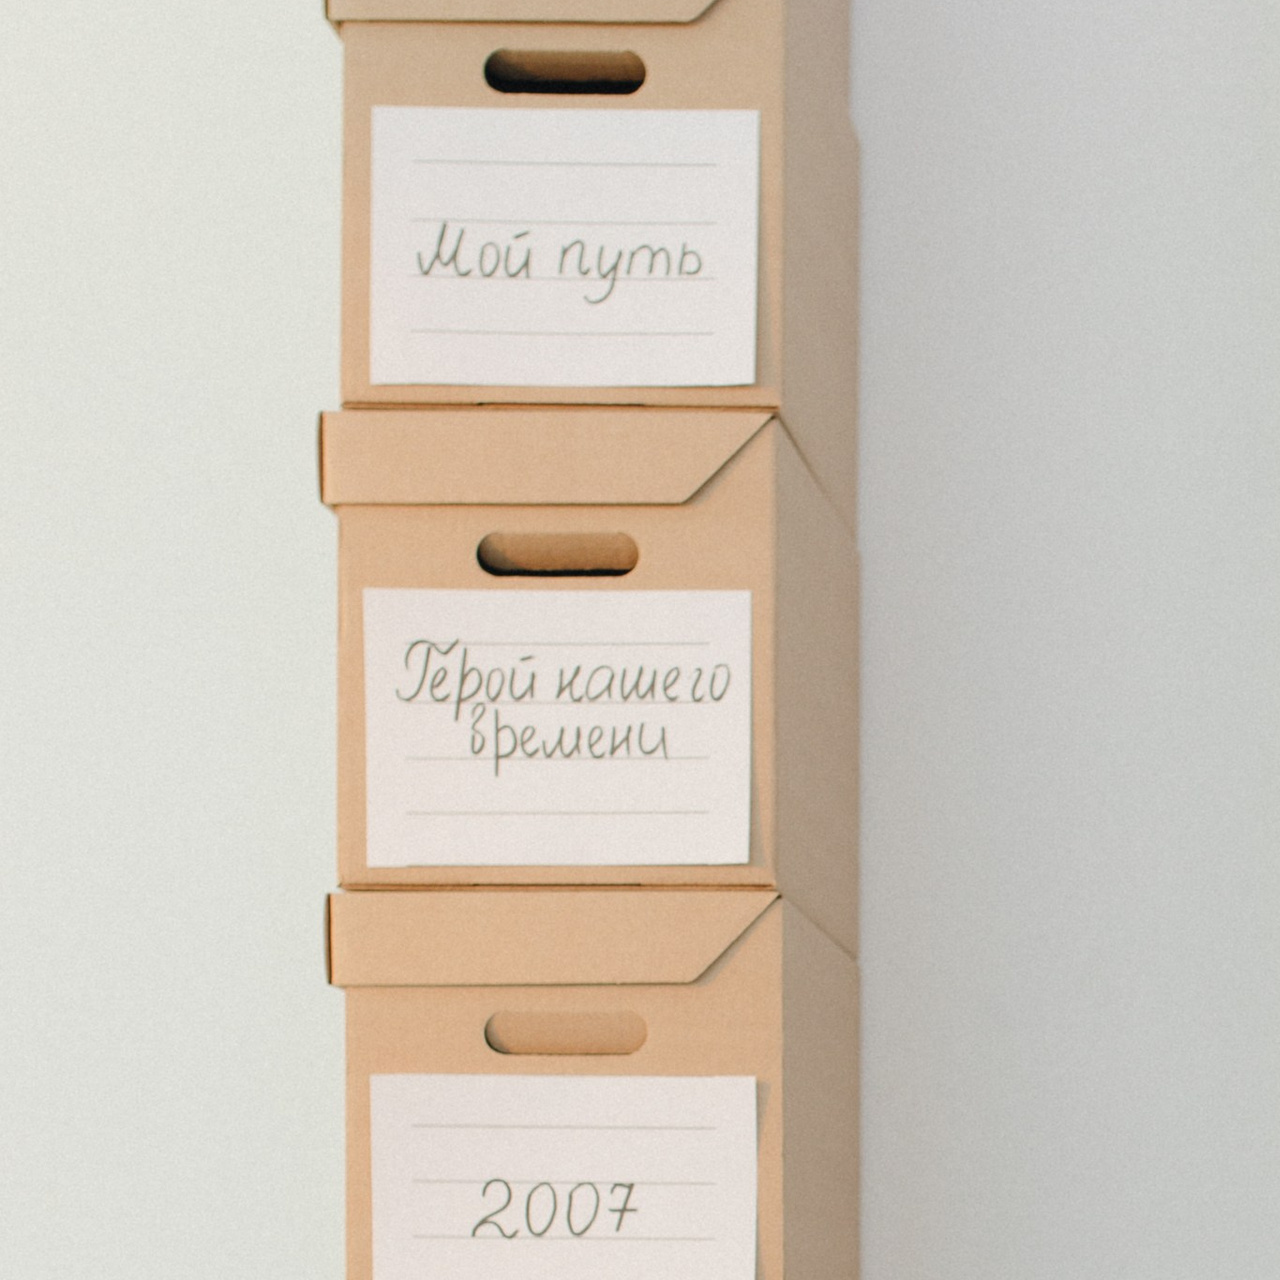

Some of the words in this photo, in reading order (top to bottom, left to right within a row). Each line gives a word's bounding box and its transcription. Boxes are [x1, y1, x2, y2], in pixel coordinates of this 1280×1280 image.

[416, 221, 531, 279] Мой
[558, 239, 703, 304] путь
[395, 637, 537, 722] Герой
[555, 661, 731, 703] нашего
[469, 702, 669, 777] времени
[470, 1178, 638, 1240] 2007
